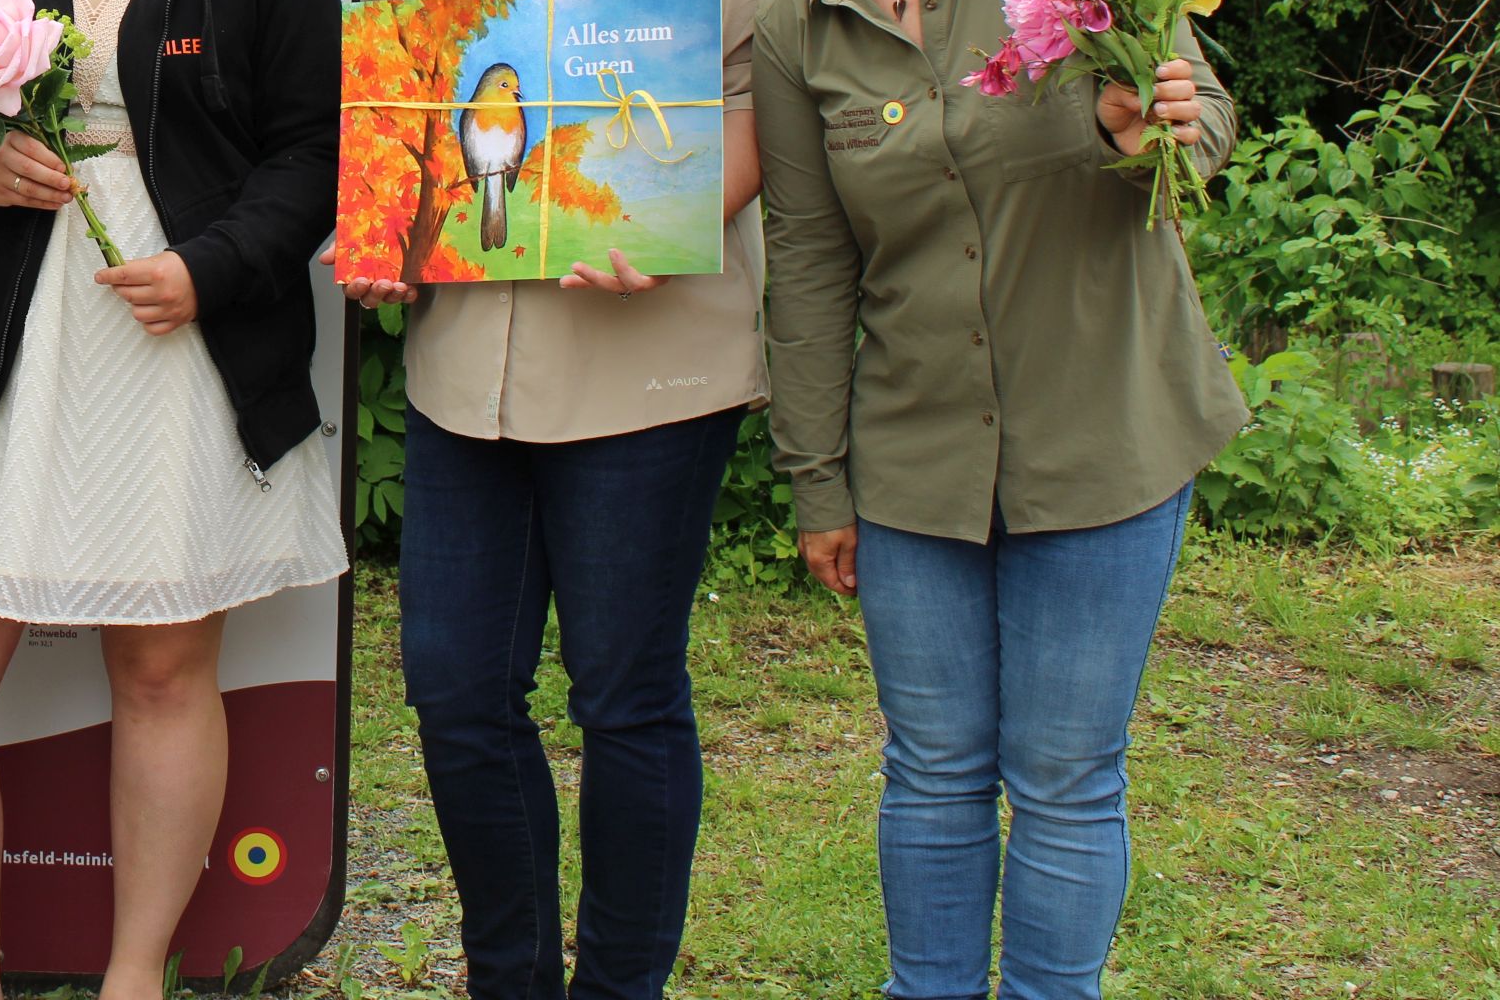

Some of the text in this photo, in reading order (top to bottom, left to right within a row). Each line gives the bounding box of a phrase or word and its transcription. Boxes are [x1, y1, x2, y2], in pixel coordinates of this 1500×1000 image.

[564, 23, 672, 46] Alles zum
[163, 38, 201, 56] ILEE
[564, 56, 634, 76] Guten
[29, 629, 77, 638] Schwebda
